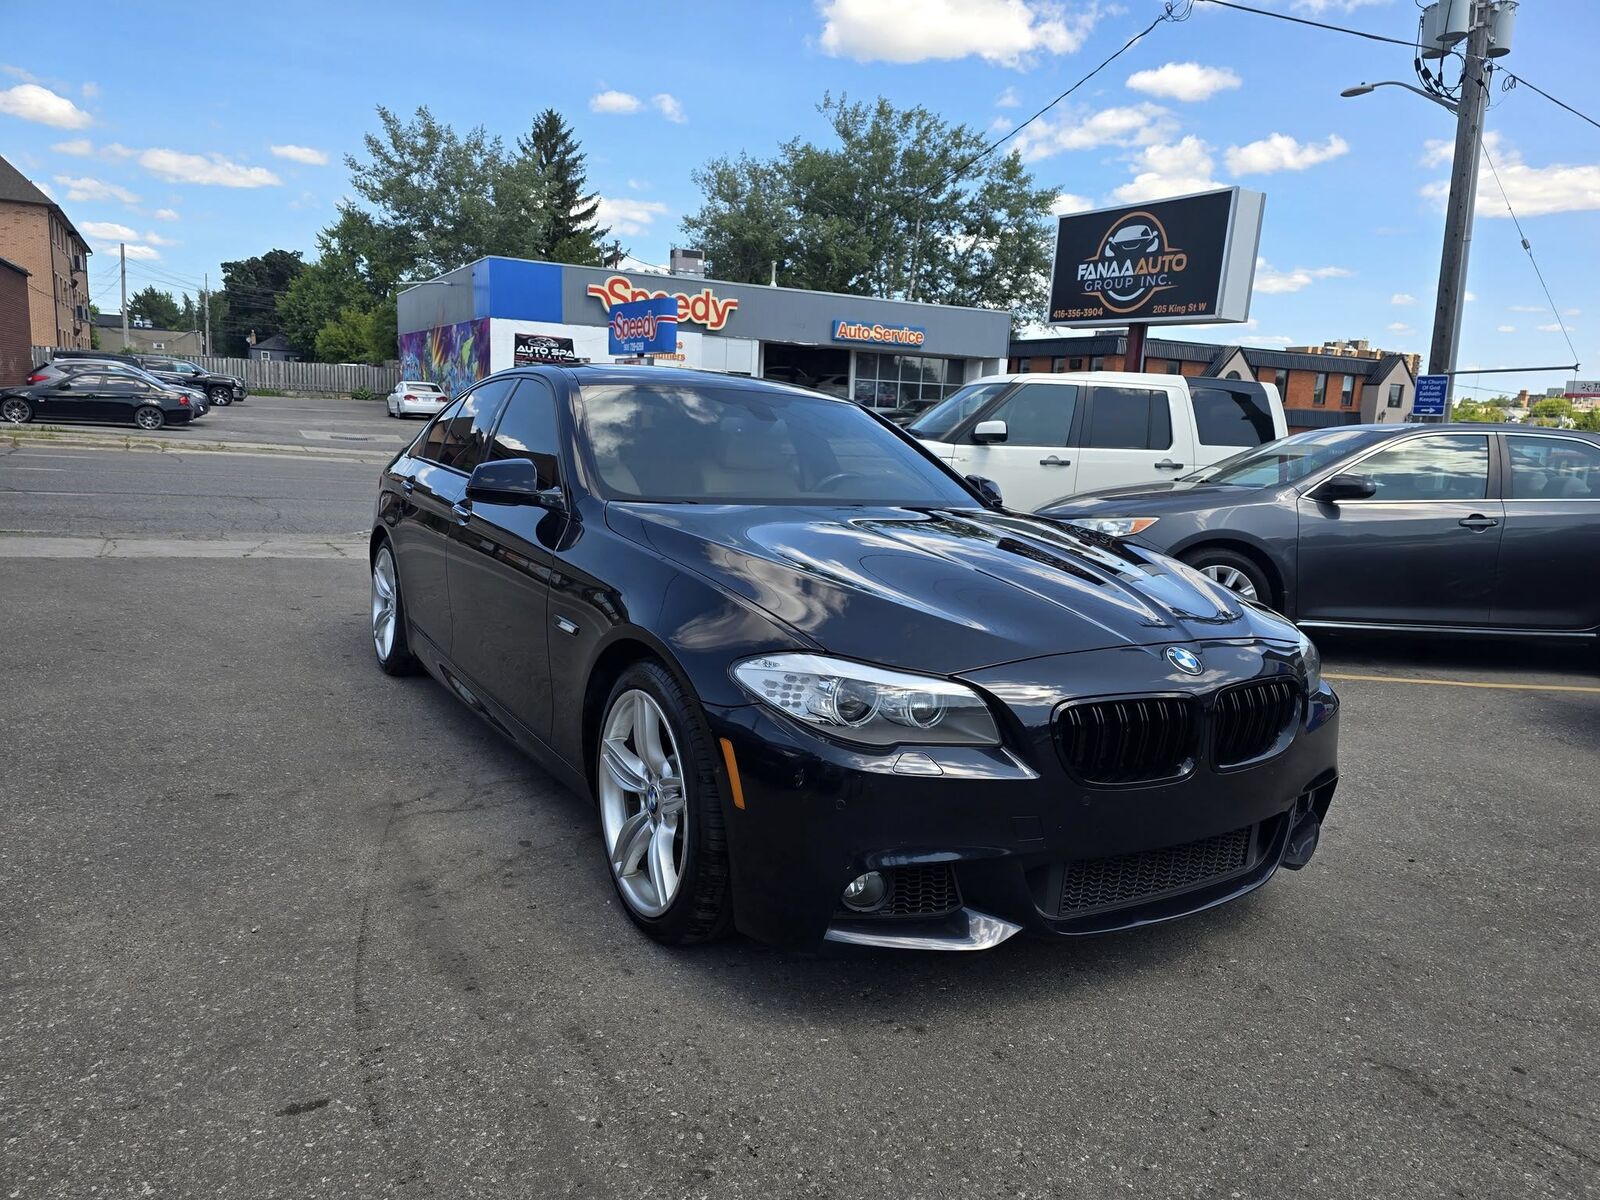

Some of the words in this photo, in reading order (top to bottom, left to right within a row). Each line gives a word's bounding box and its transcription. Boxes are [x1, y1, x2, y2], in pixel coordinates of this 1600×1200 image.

[1084, 277, 1134, 292] GROUP
[1140, 274, 1172, 287] INC.
[588, 276, 738, 329] Sedy
[1152, 304, 1167, 314] 205
[1168, 304, 1186, 314] King
[1187, 303, 1197, 312] St
[1198, 302, 1207, 311] W
[611, 310, 659, 344] Speedy
[836, 322, 871, 340] Auto
[873, 324, 925, 345] Service
[516, 344, 549, 355] AUTO
[551, 348, 575, 358] SPA
